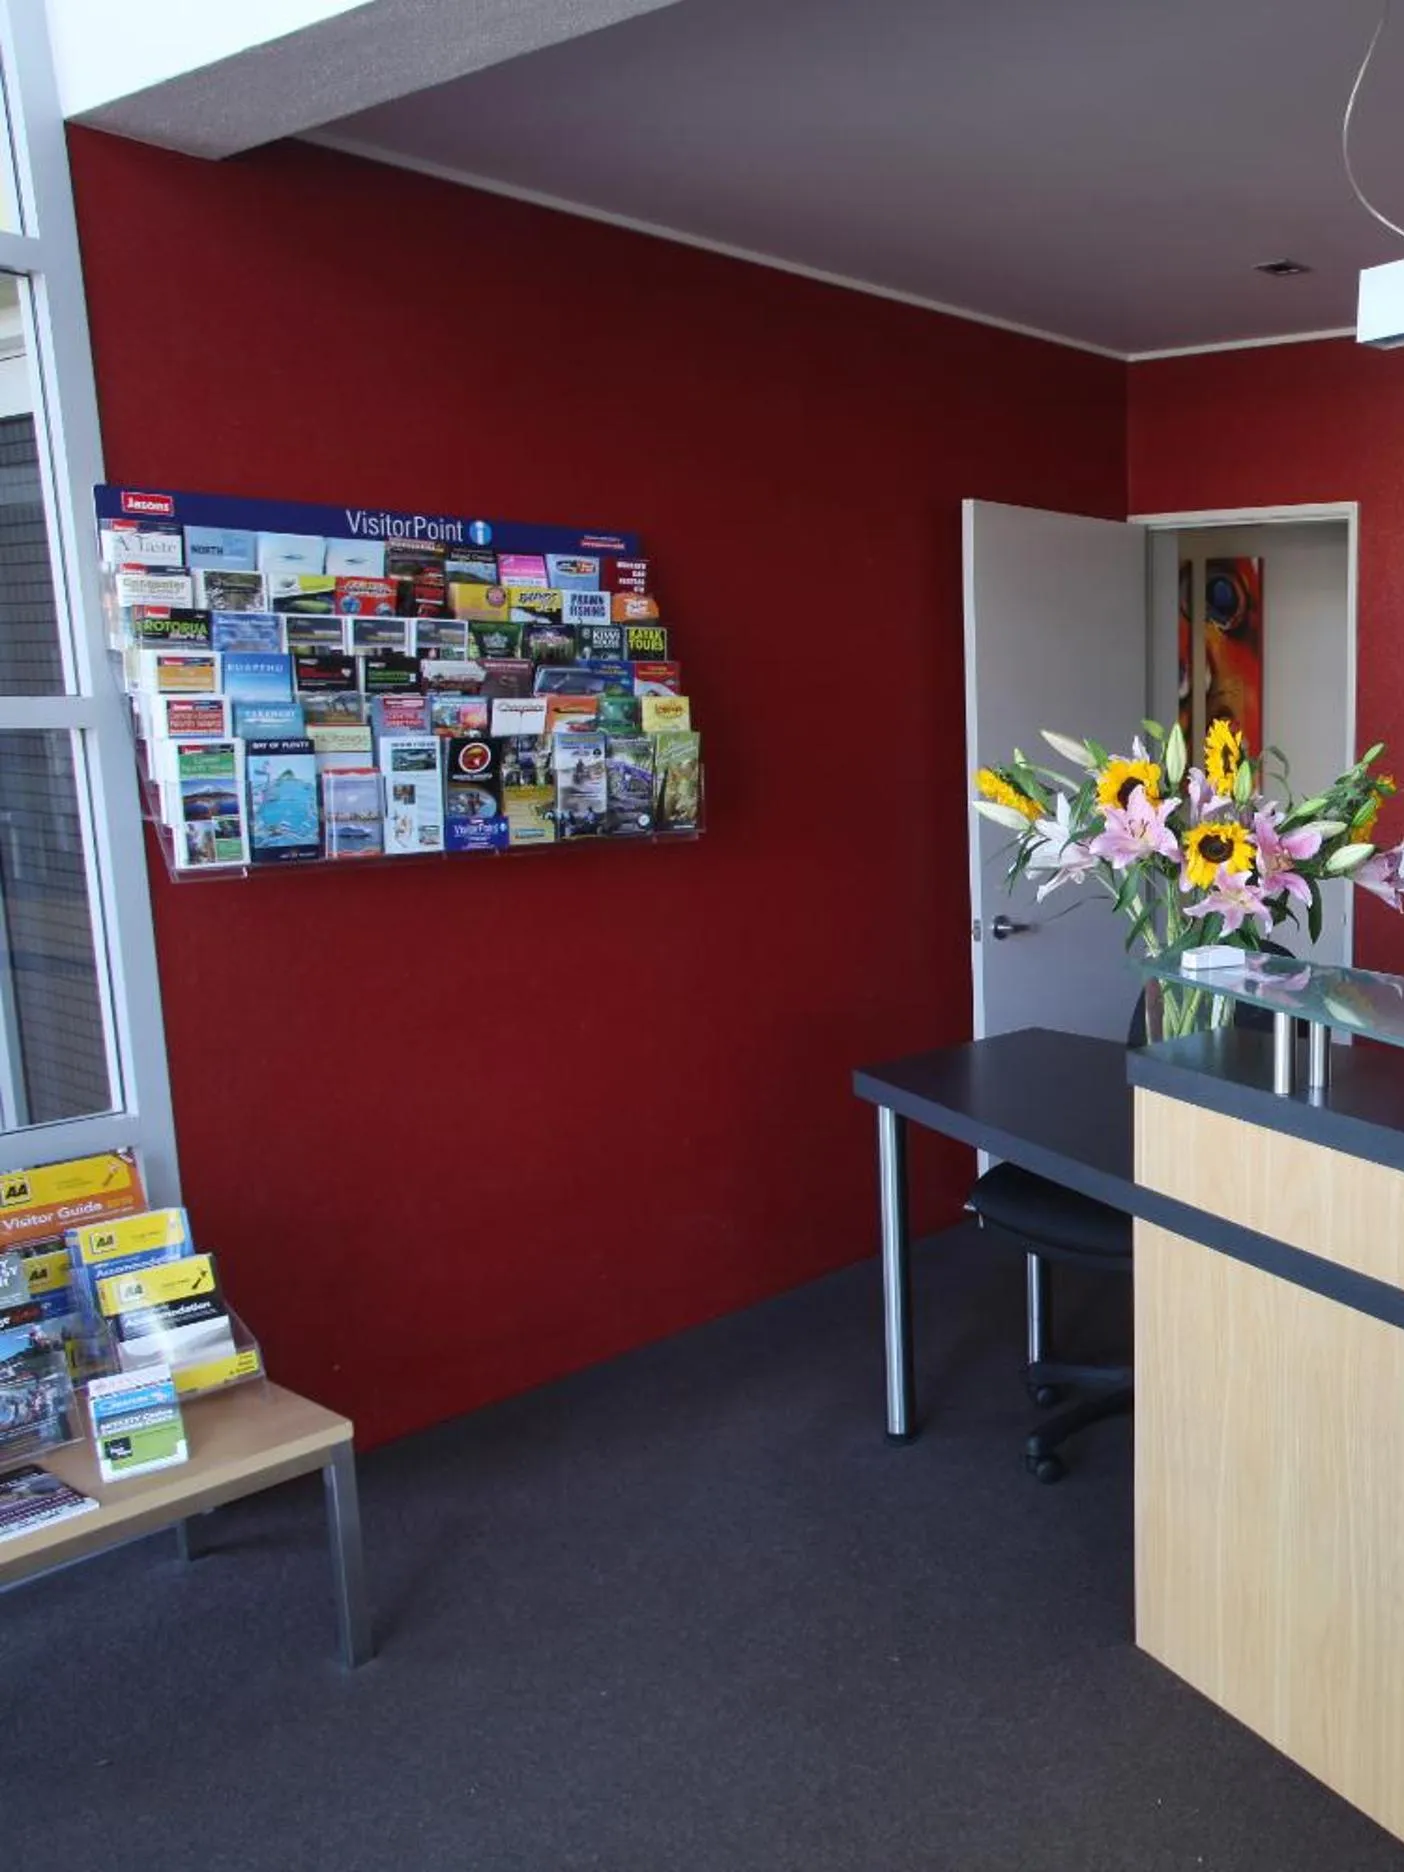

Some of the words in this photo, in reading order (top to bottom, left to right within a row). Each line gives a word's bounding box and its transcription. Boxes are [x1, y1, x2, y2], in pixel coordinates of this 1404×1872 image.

[345, 509, 464, 542] VisitorPoint
[2, 1211, 54, 1231] Visitor
[58, 1202, 103, 1220] Guide
